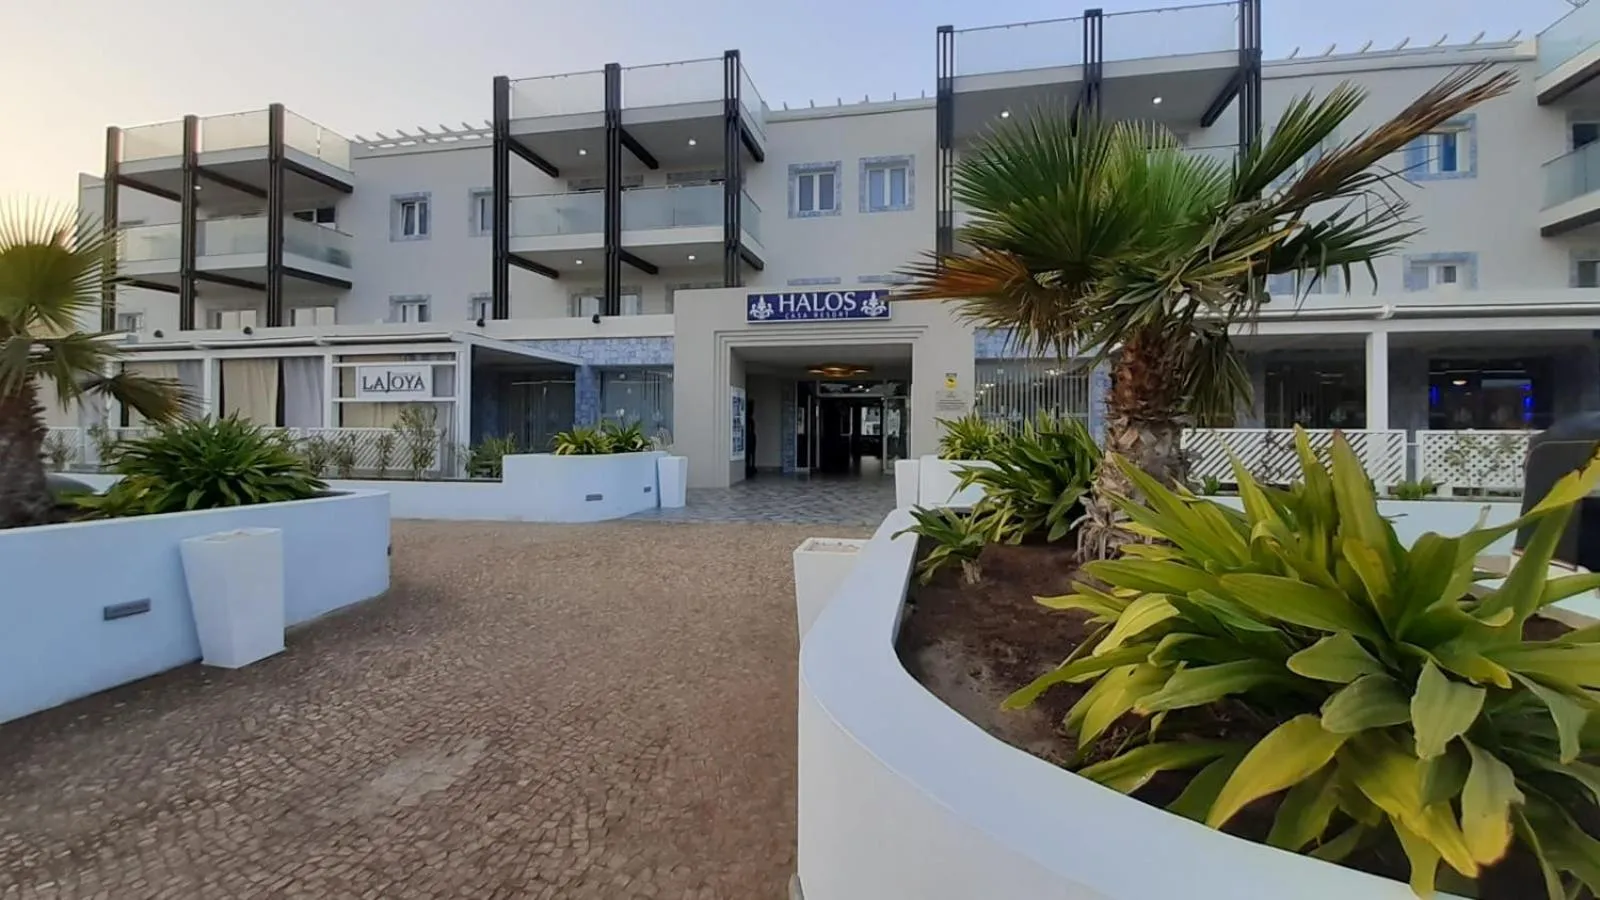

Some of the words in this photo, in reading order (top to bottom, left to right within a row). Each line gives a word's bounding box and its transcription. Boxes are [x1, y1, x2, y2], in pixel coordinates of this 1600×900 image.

[778, 291, 857, 313] HALOS
[785, 312, 808, 320] CASA
[814, 311, 849, 319] RESORT
